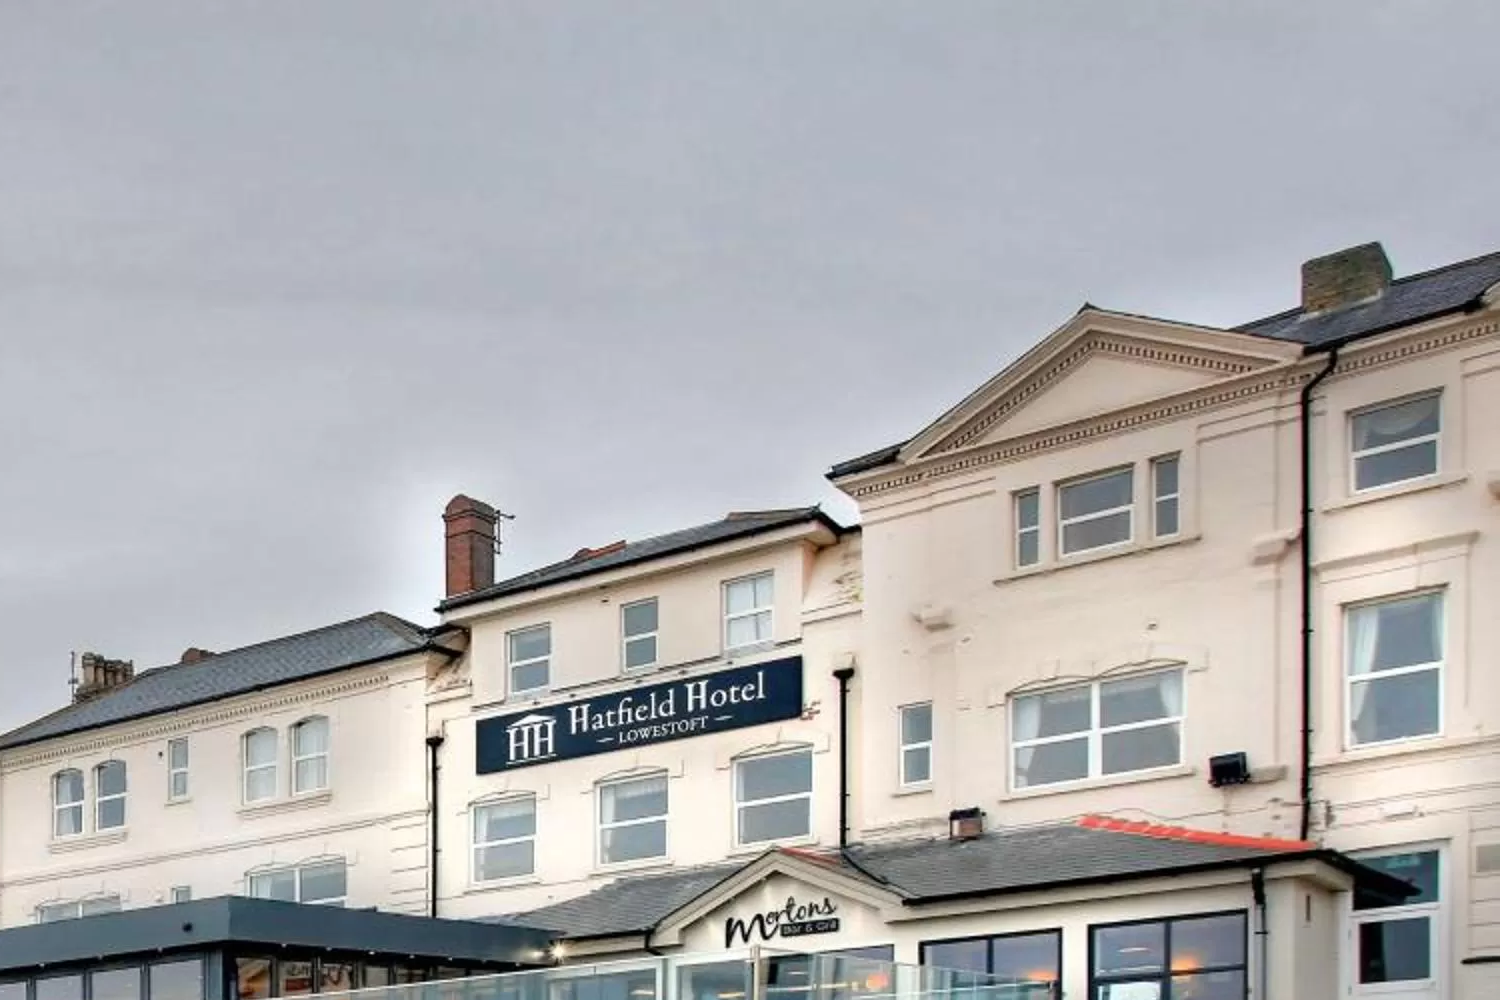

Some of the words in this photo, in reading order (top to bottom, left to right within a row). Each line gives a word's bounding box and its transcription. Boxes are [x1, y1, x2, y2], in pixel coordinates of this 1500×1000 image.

[567, 689, 677, 736] Hatfield
[684, 671, 767, 714] Hotel
[618, 716, 710, 744] LOWESTOFT
[725, 895, 837, 949] Mortons
